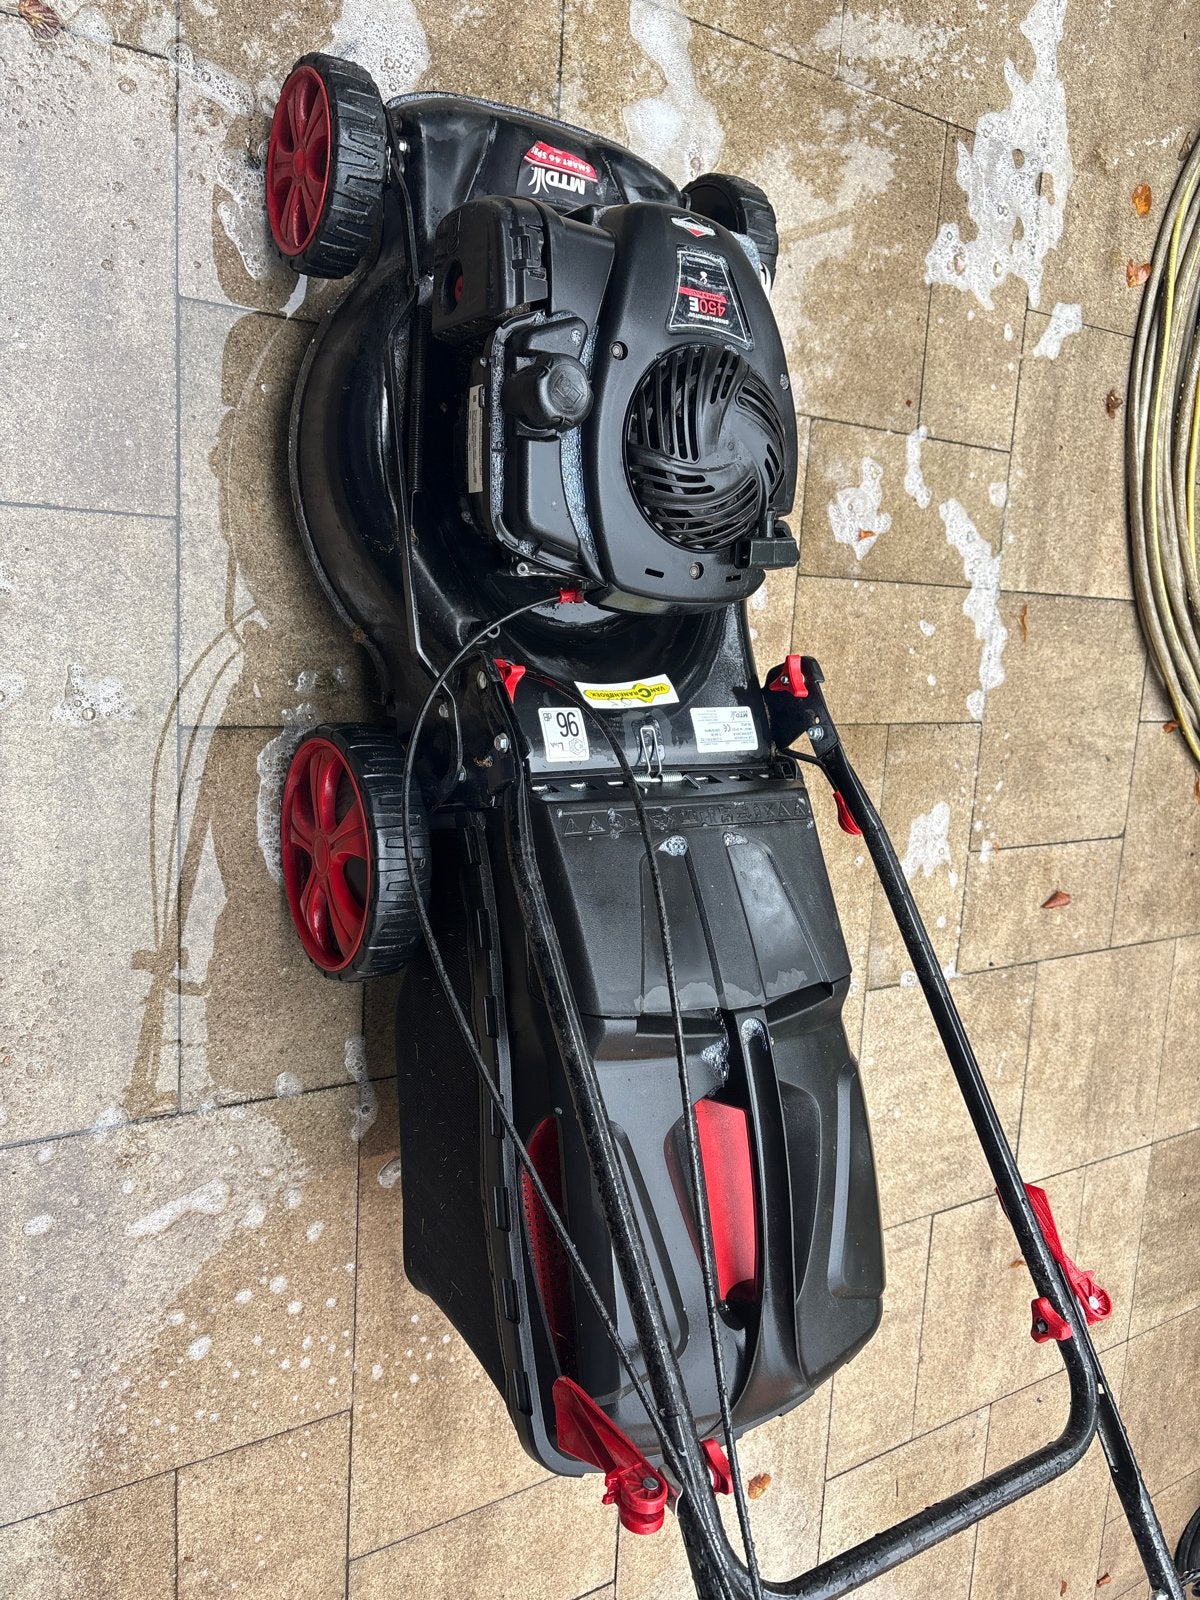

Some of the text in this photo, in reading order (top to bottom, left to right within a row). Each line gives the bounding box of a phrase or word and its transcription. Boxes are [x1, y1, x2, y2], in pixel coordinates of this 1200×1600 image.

[548, 154, 561, 164] 46
[563, 158, 591, 173] SMART
[545, 170, 586, 195] MTD
[689, 296, 726, 316] 450E
[650, 685, 666, 693] VAN
[543, 711, 580, 737] 96 dB
